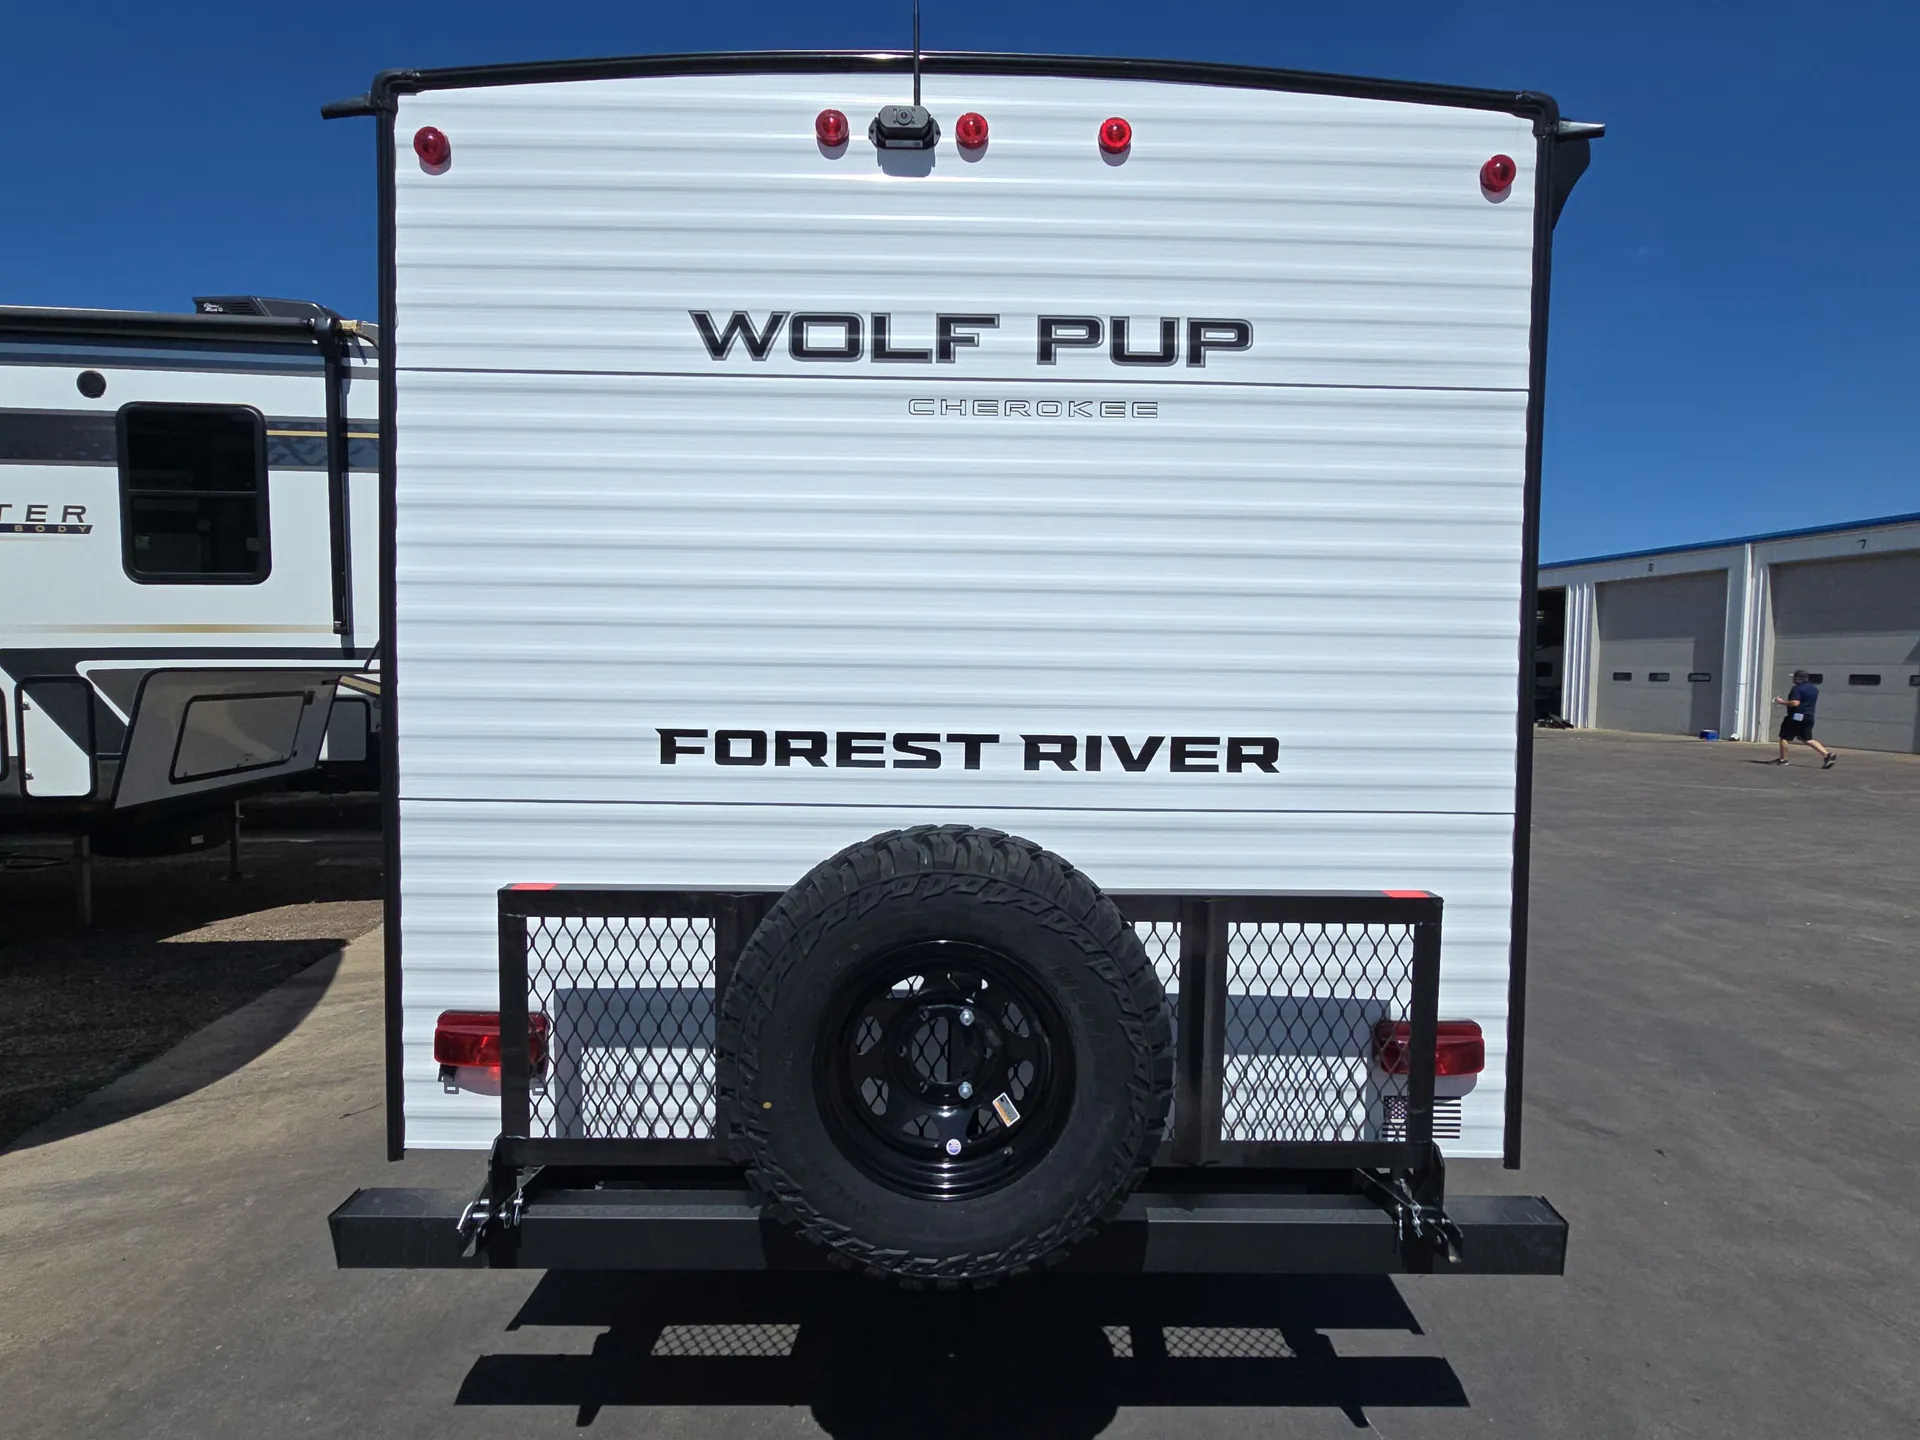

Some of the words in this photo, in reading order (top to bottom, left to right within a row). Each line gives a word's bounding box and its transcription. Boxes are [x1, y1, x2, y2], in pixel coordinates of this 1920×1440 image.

[688, 309, 1000, 363] WOLF
[1036, 314, 1254, 368] PUP
[908, 398, 1159, 419] CHEROKEE
[14, 525, 87, 533] BODY
[1857, 539, 1867, 550] 7
[655, 728, 1000, 770] FOREST
[1019, 734, 1280, 774] RIVER
